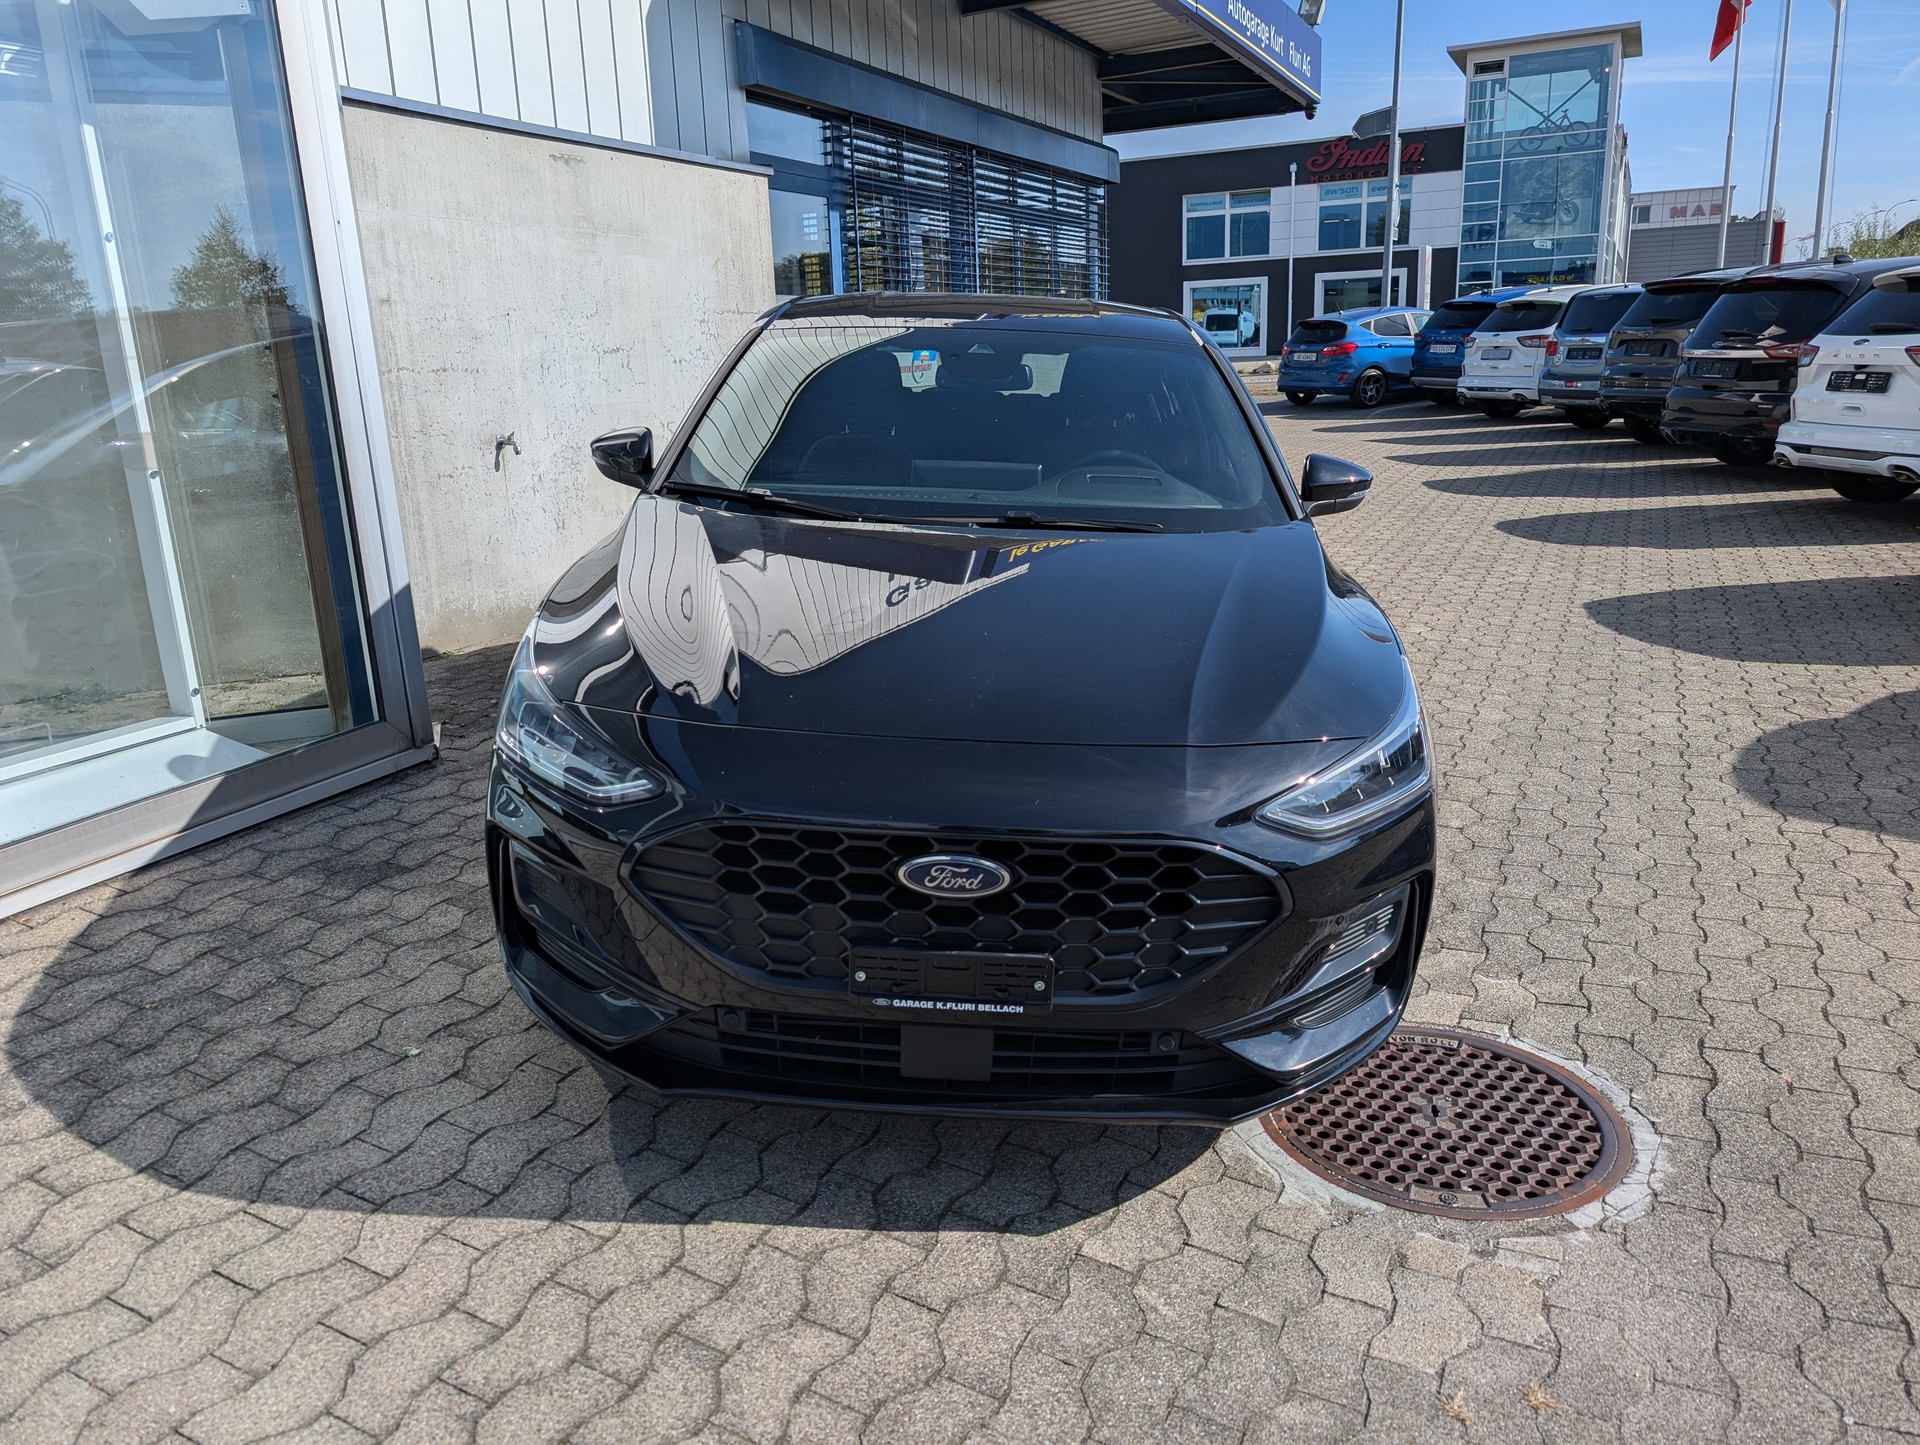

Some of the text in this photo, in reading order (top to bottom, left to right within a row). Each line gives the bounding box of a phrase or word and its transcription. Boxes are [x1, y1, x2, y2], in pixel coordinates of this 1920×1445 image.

[1228, 0, 1311, 78] Autogarage Kurt Fluri AG
[1306, 137, 1425, 173] Indin
[1310, 166, 1421, 184] MOTORCYLE
[924, 864, 984, 890] Ford
[892, 999, 934, 1010] GARAGE
[936, 1001, 976, 1012] K.FLURI
[977, 1003, 1024, 1014] BELLACH
[1421, 1037, 1455, 1047] ROLL
